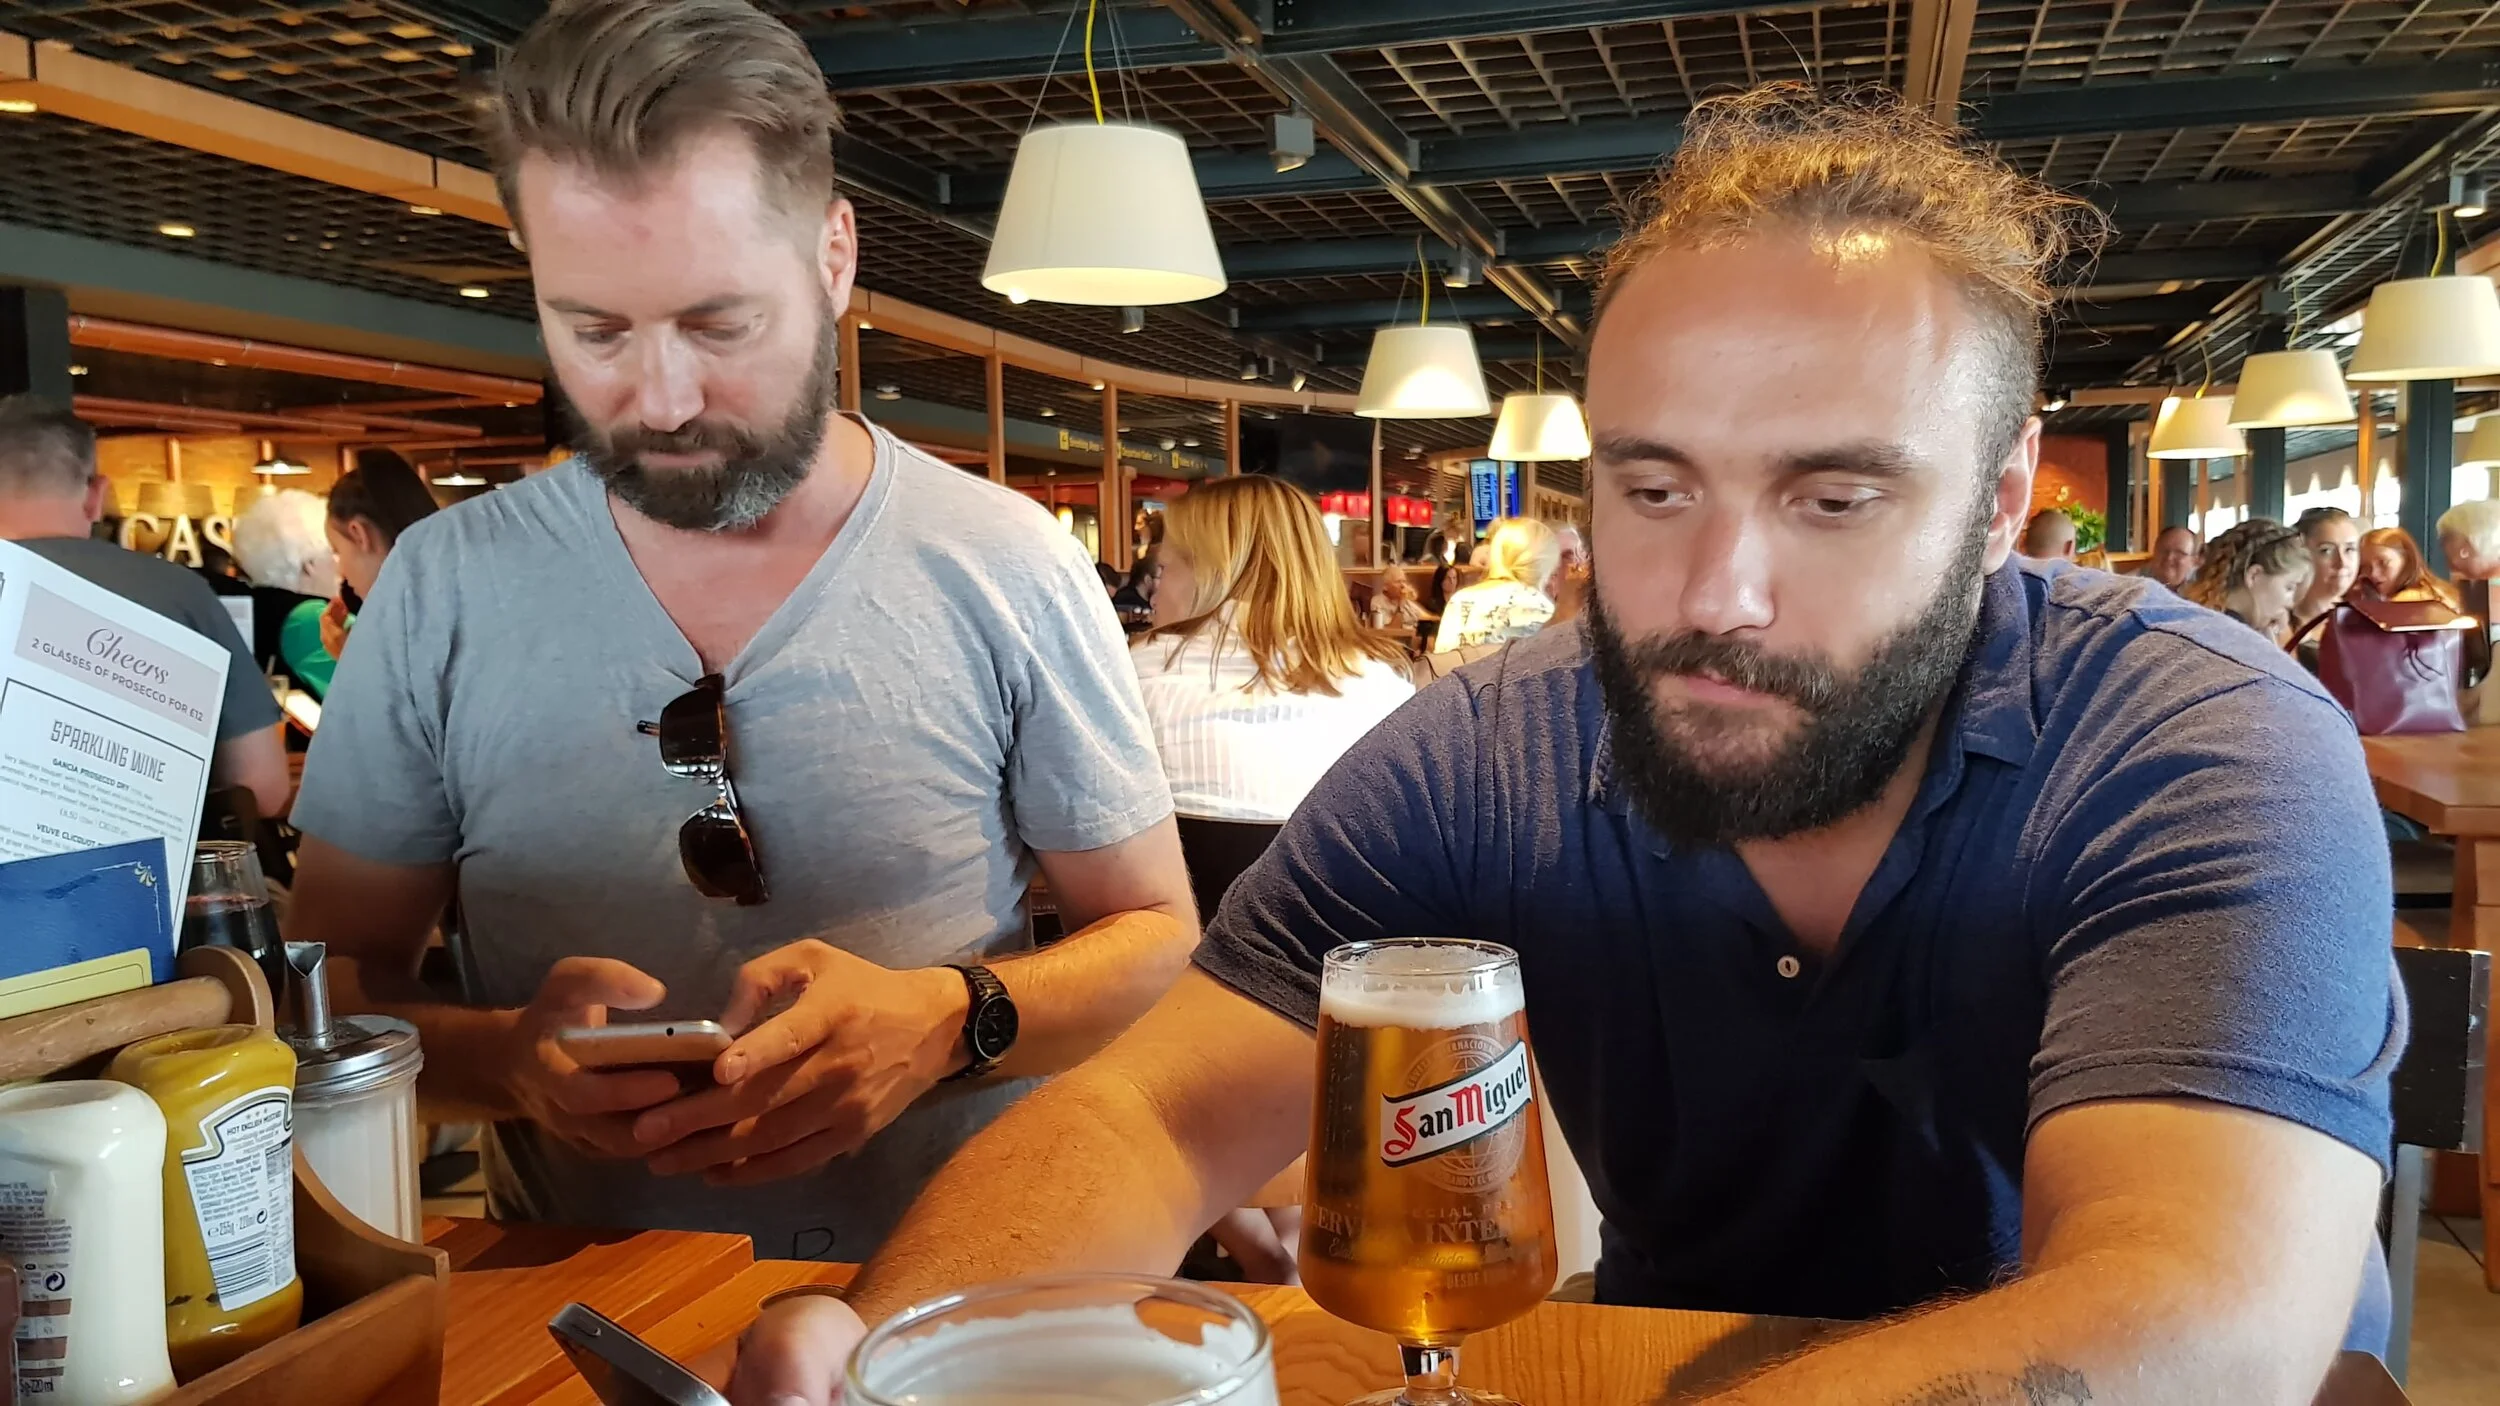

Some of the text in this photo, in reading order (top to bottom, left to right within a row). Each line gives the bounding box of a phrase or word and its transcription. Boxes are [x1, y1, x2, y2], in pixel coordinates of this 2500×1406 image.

[31, 637, 40, 650] 2
[42, 642, 92, 672] GLASSES
[94, 665, 110, 678] OF
[112, 672, 167, 704] PROSECCO
[168, 697, 188, 714] FOR
[86, 628, 170, 685] Cheers
[50, 720, 166, 783] SPARKLING WINE
